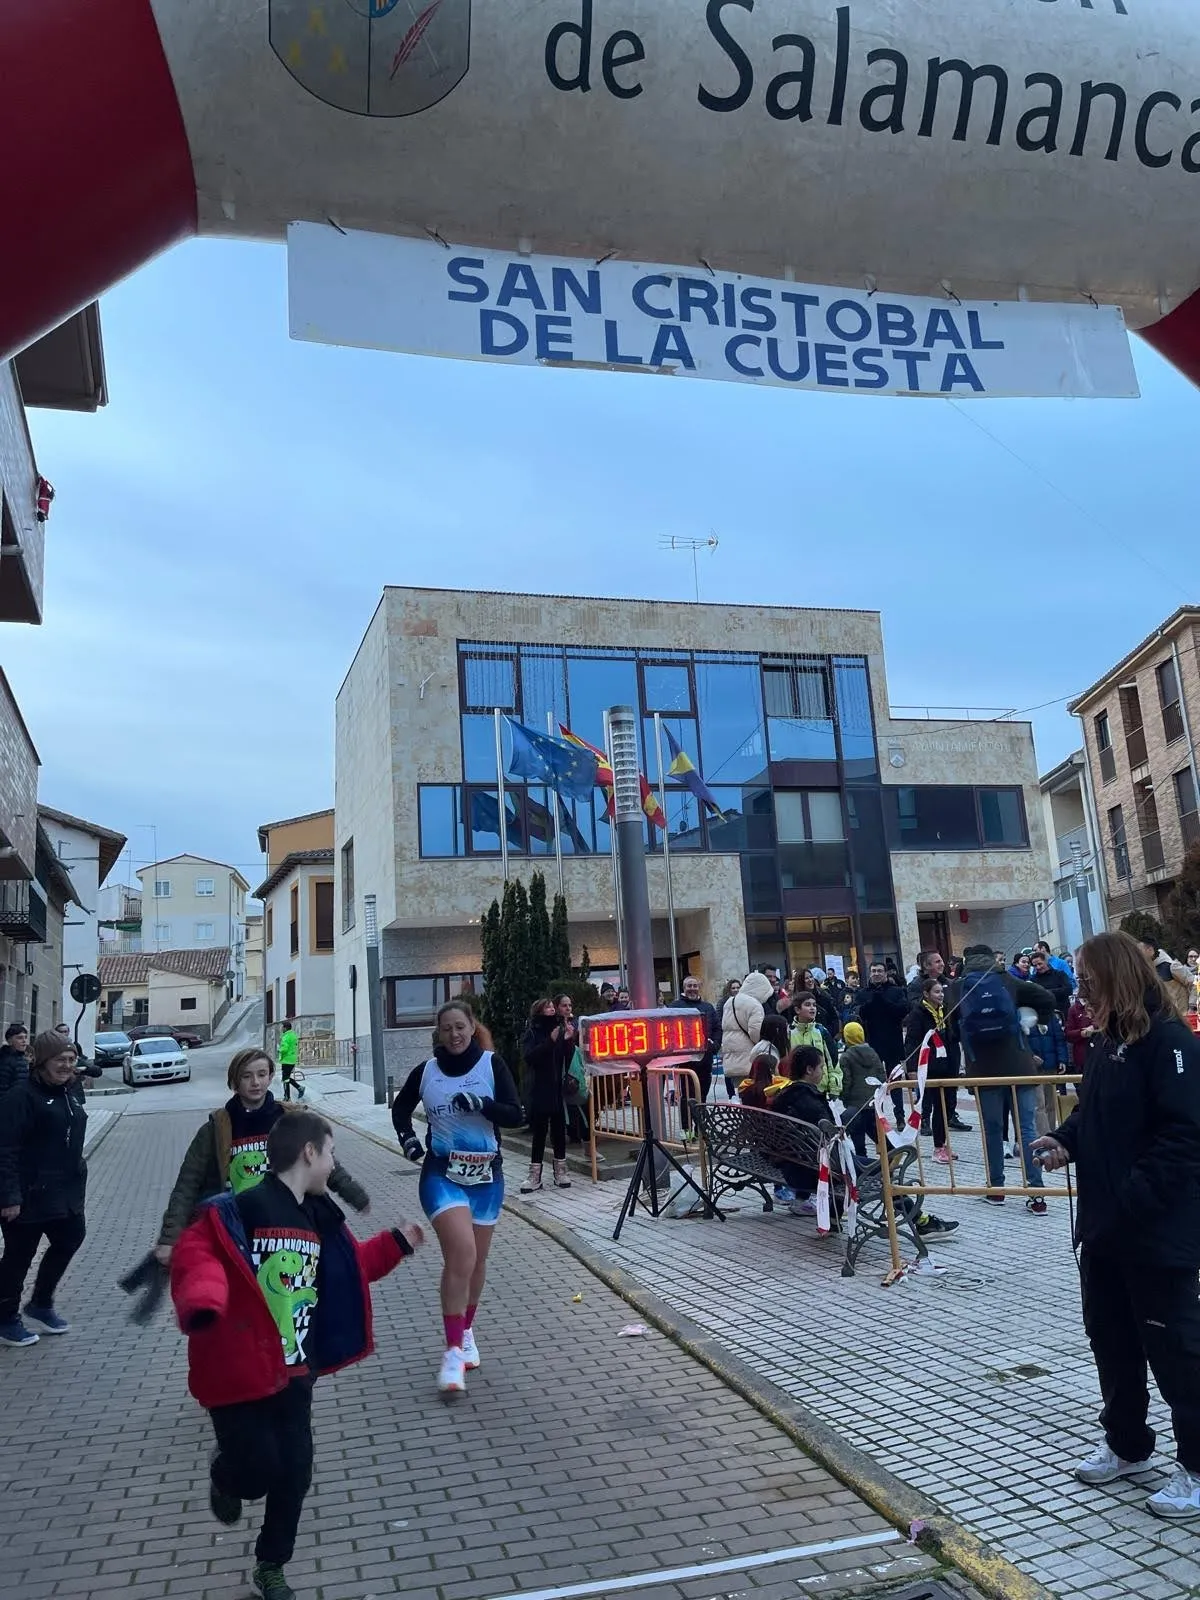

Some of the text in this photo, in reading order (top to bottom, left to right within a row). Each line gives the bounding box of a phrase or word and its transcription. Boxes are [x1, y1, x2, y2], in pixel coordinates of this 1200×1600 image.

[545, 0, 646, 99] de
[447, 256, 1005, 351] SAN CRISTOBAL
[479, 308, 986, 392] DE LA CUESTA
[458, 1163, 485, 1178] 322
